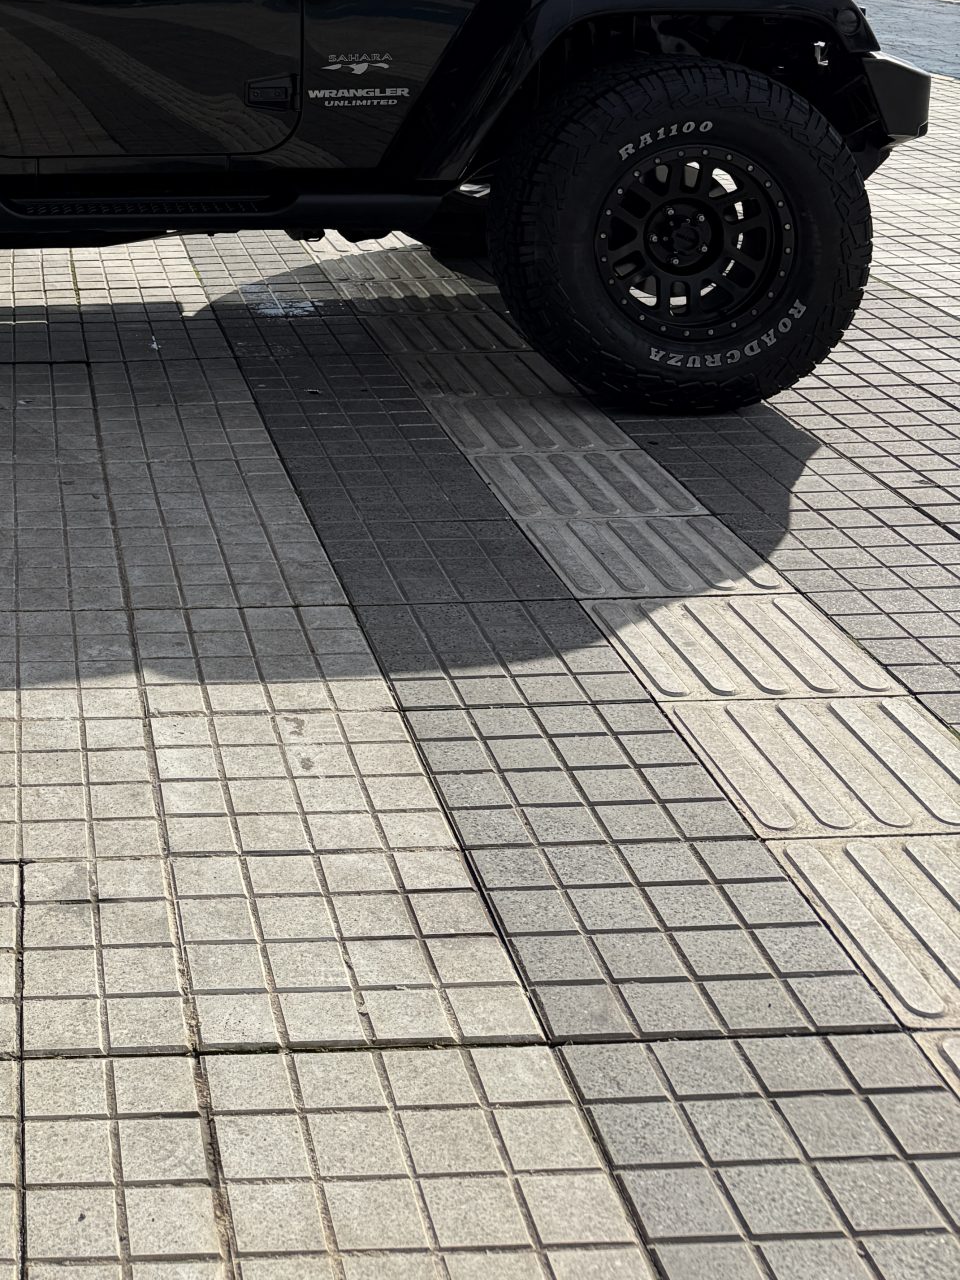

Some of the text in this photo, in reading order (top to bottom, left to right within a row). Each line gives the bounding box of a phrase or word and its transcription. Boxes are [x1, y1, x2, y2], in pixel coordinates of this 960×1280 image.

[328, 52, 393, 62] SAHARA
[307, 87, 410, 98] WRANGLER
[324, 99, 398, 107] UNLIMITED
[617, 120, 714, 161] RA1100
[649, 299, 807, 368] ROADCRUZA
